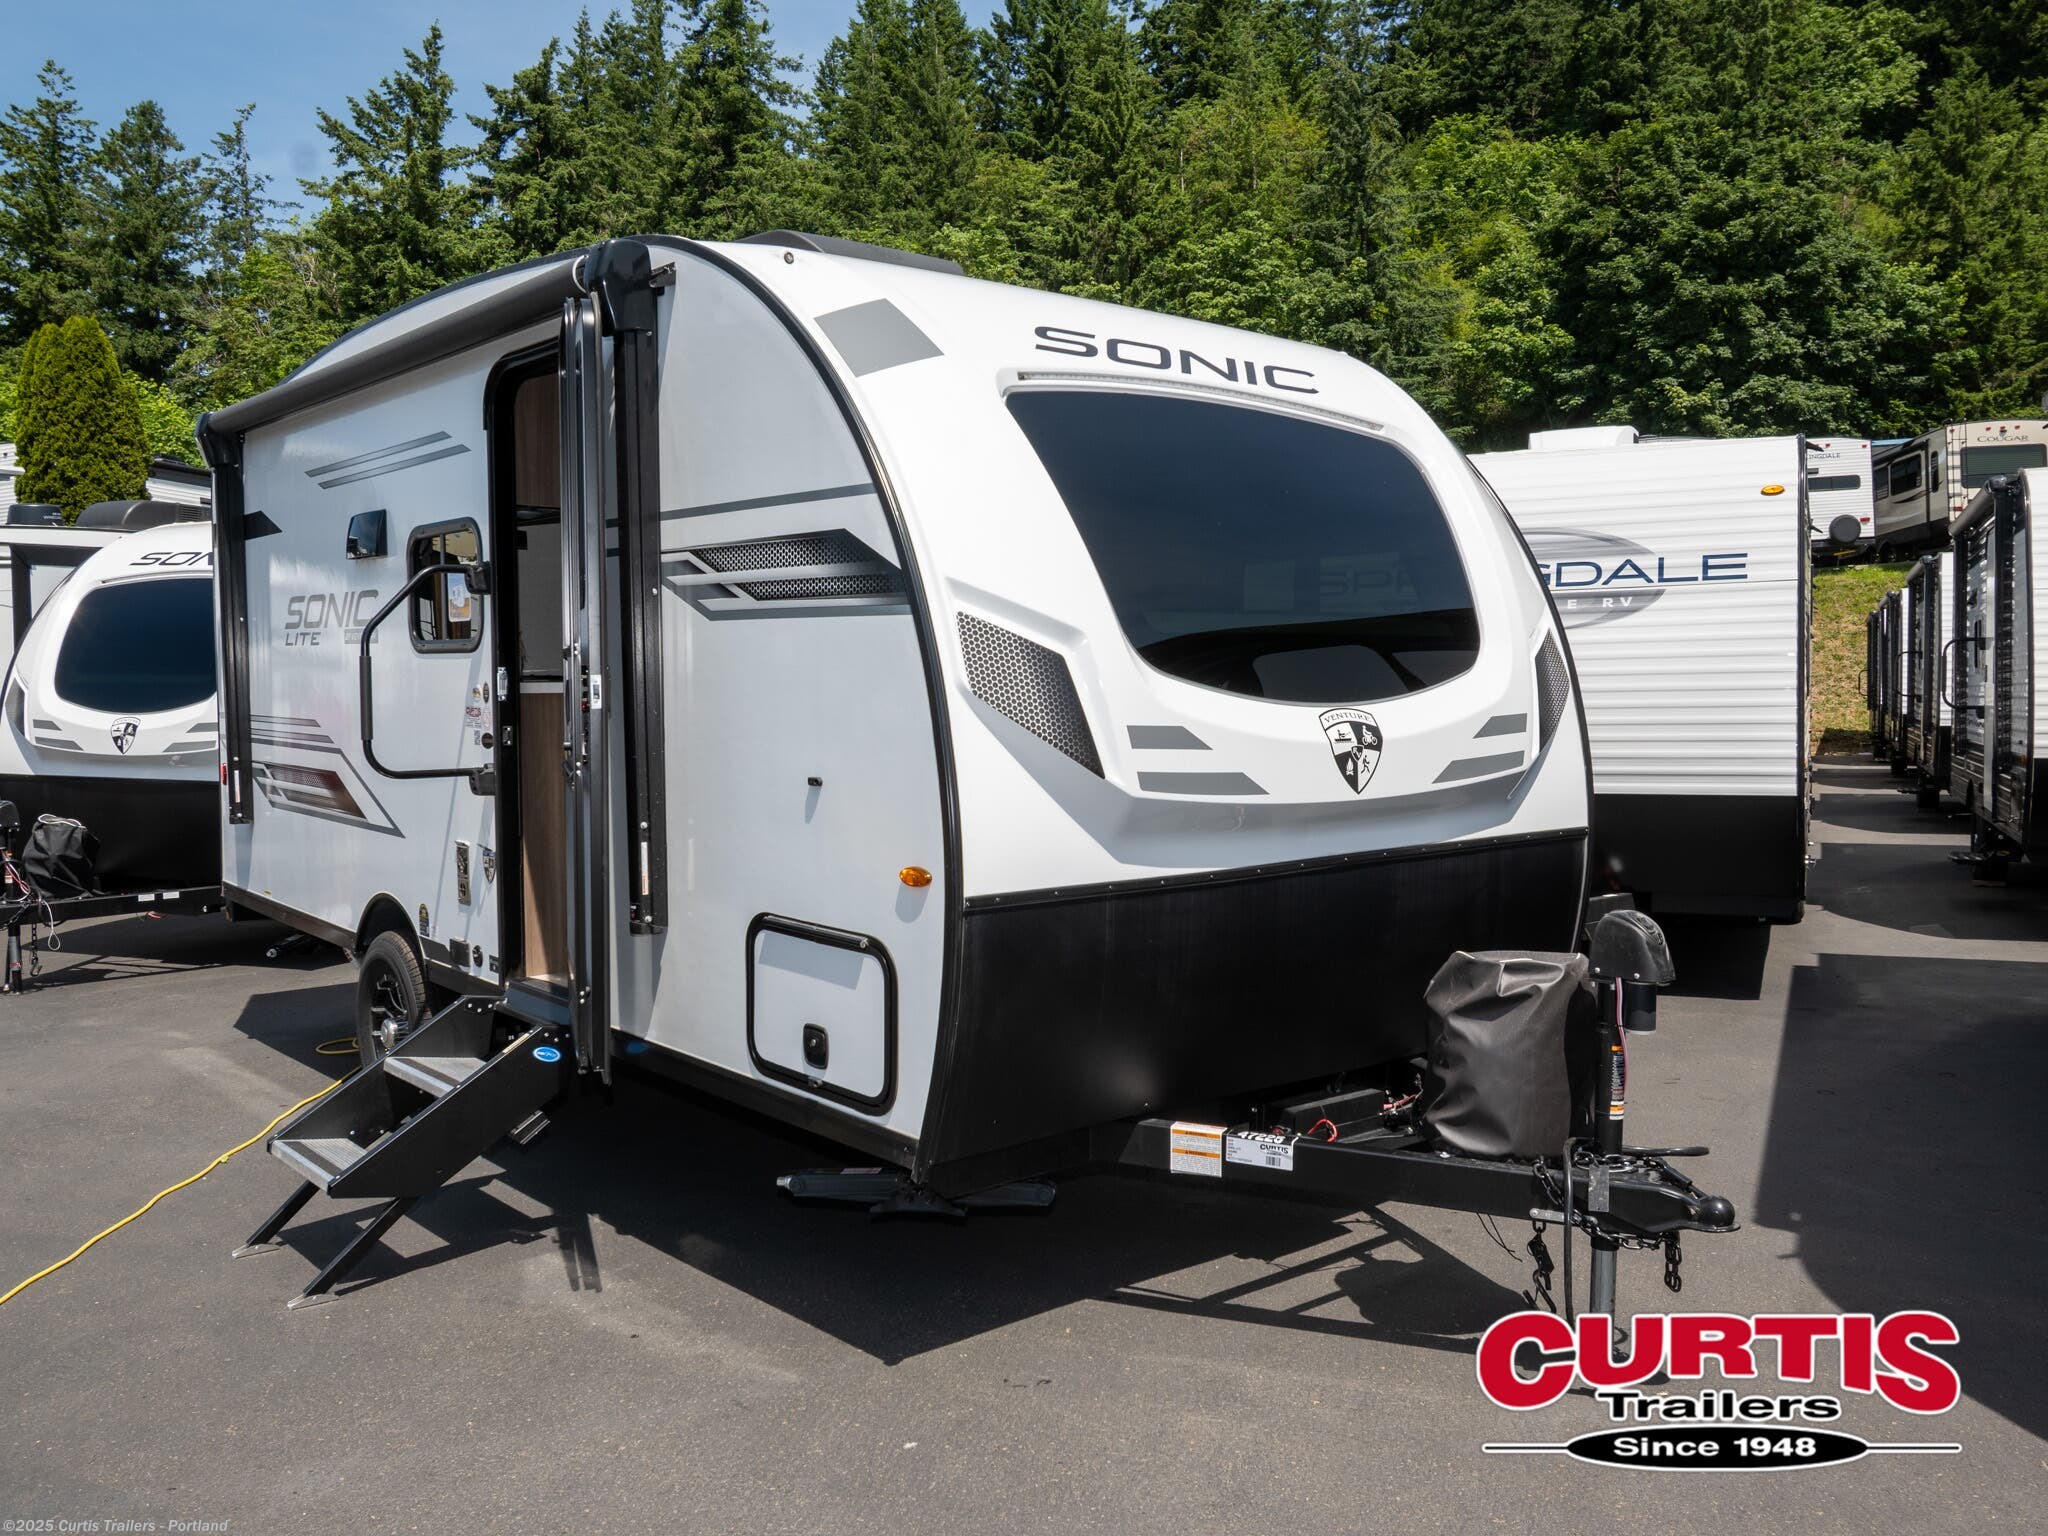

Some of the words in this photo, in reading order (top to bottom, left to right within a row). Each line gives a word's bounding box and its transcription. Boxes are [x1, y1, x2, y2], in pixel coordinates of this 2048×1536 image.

[1034, 326, 1319, 394] SONIC
[1977, 434, 2029, 442] COUGAR
[285, 589, 379, 630] SONIC
[1602, 597, 1633, 608] RV
[285, 631, 321, 646] LITE
